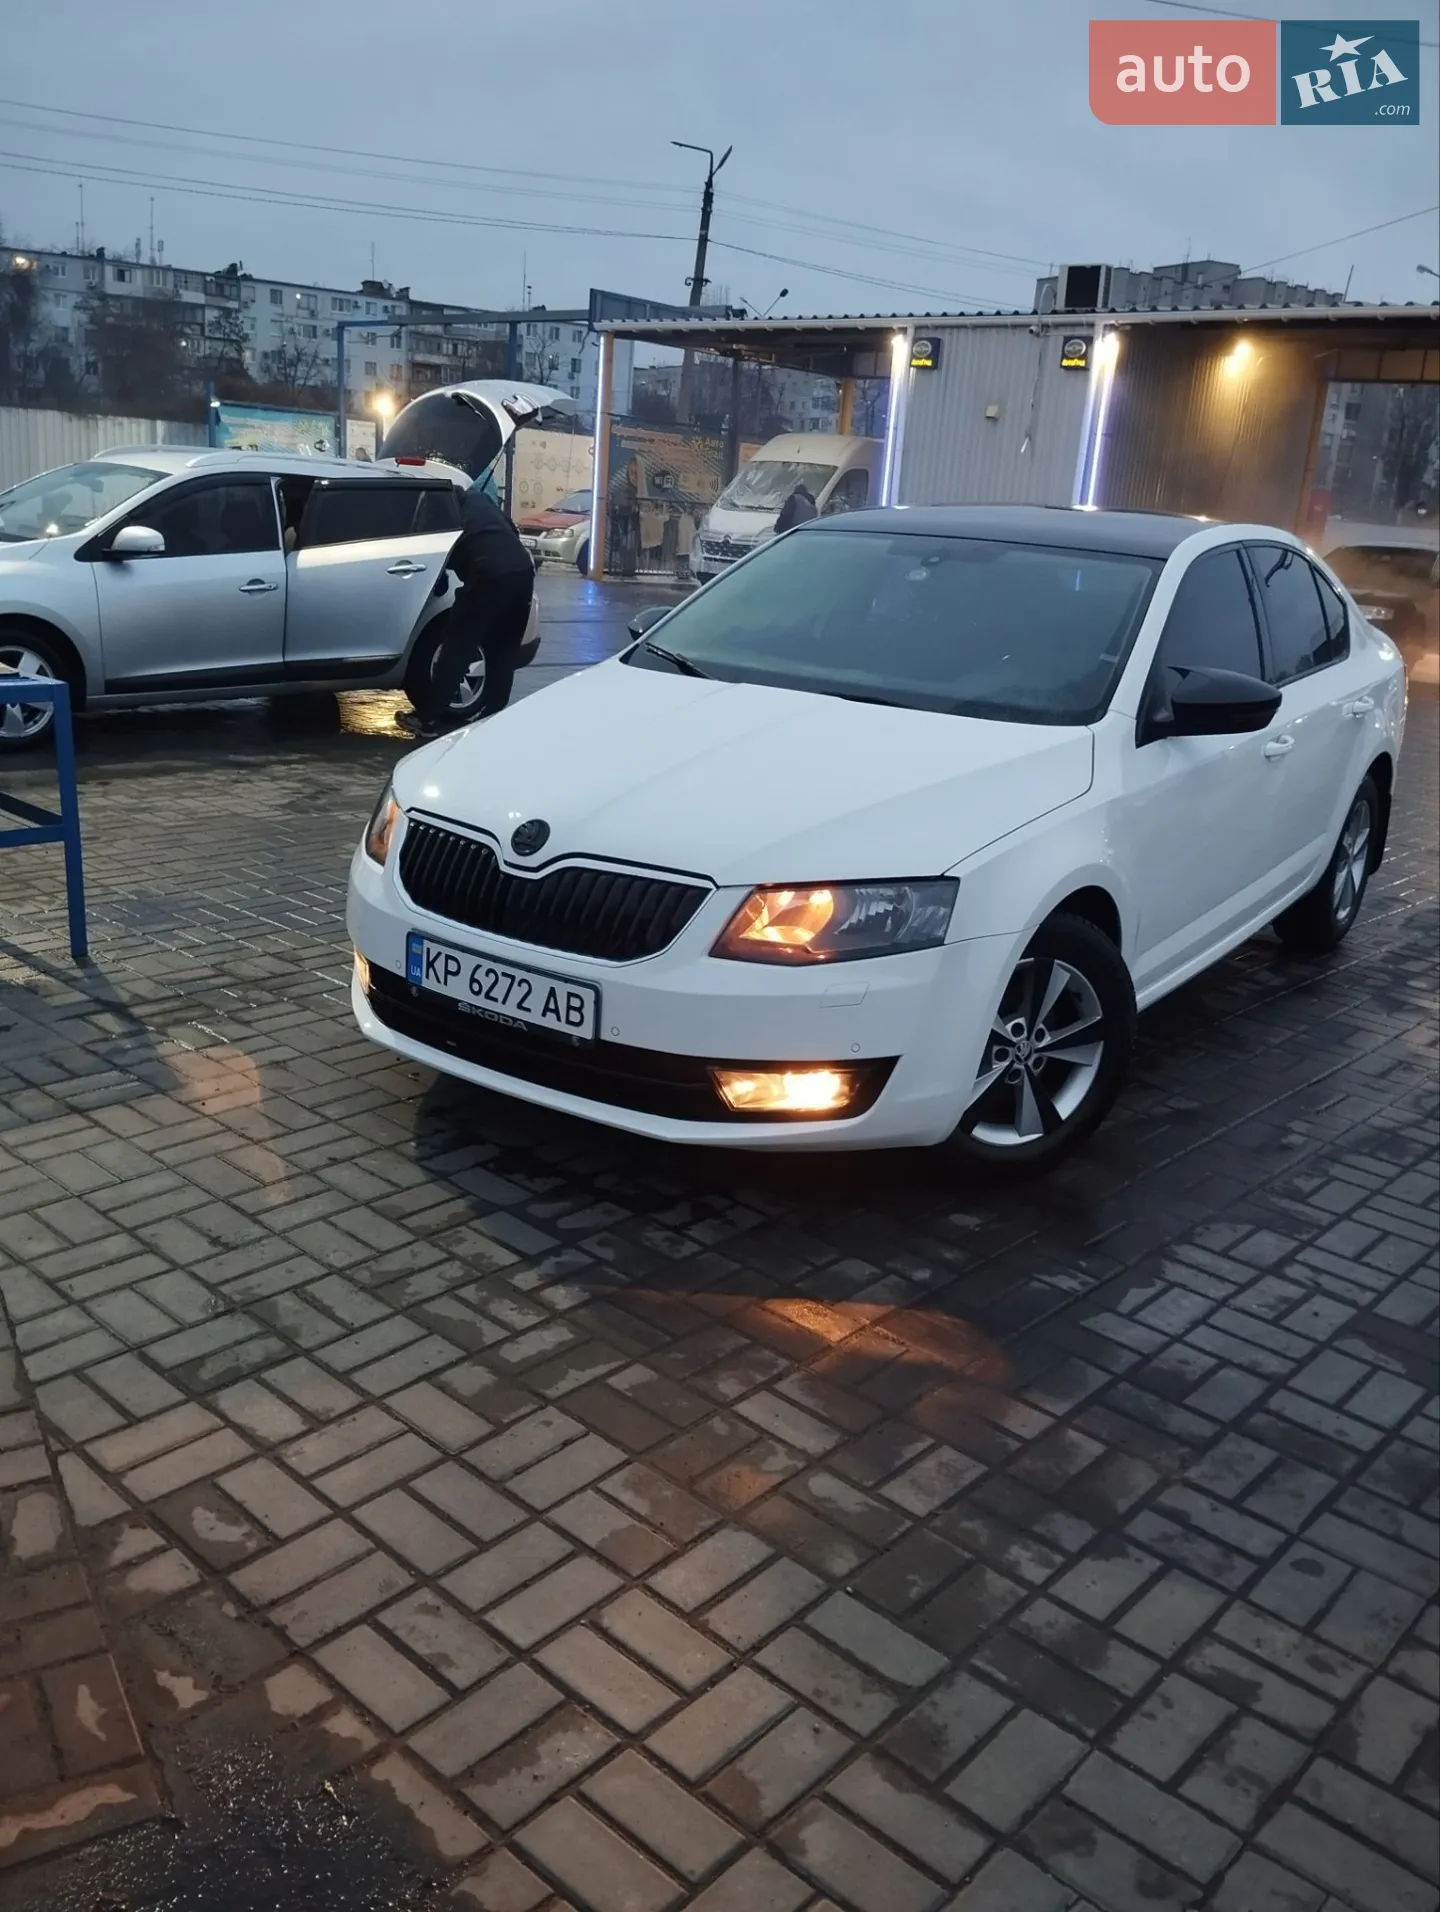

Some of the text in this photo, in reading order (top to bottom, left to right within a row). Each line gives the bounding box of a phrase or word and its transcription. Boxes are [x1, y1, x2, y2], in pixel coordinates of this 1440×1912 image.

[410, 964, 421, 977] UA
[425, 947, 585, 1027] KP 6272 AB
